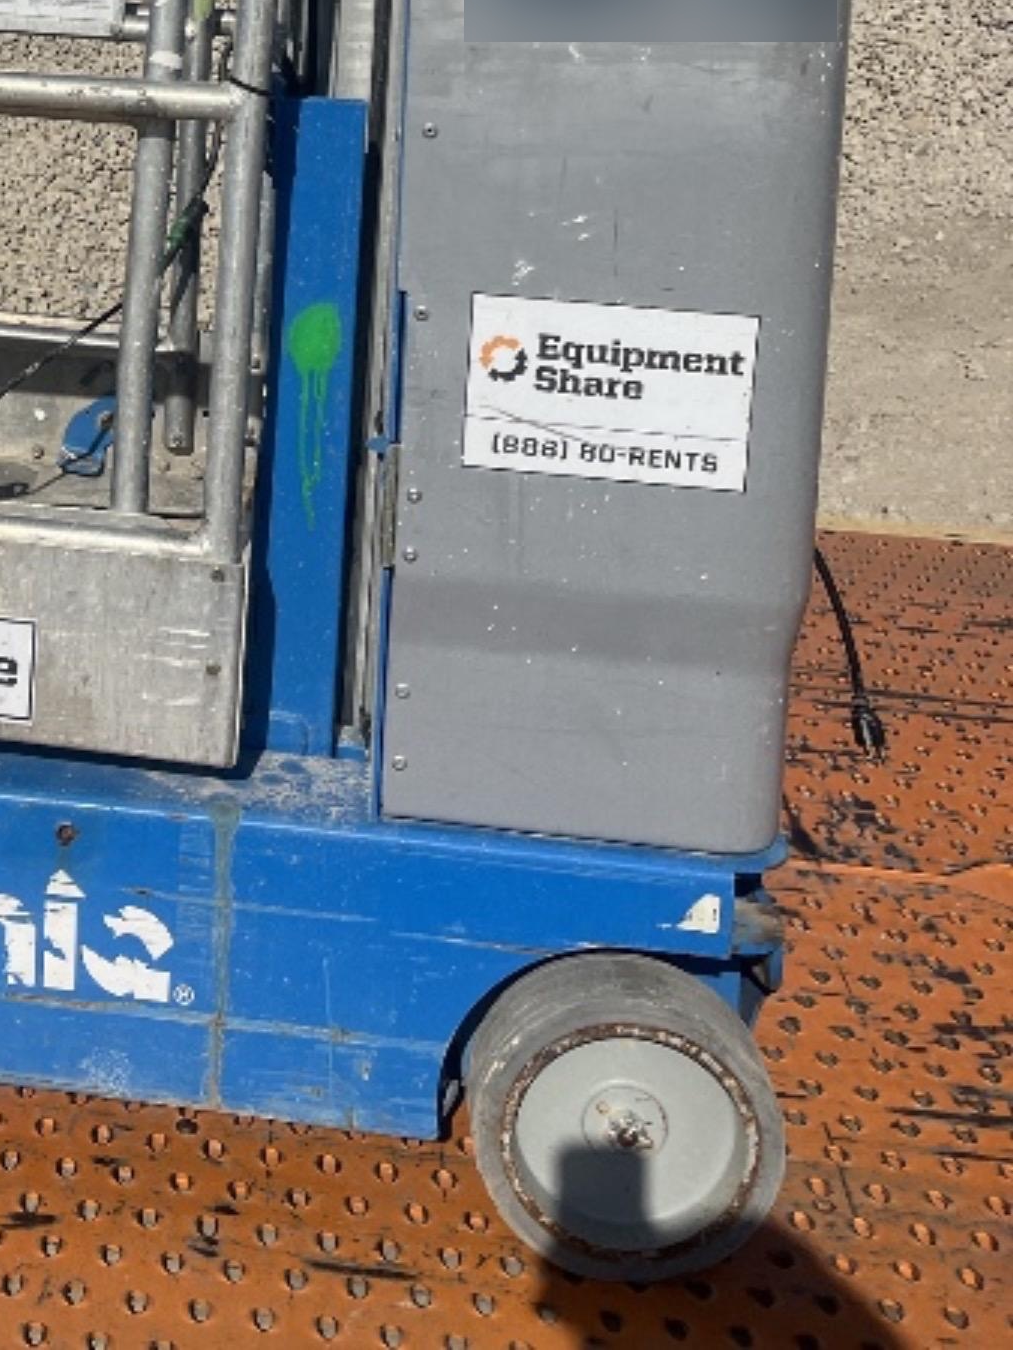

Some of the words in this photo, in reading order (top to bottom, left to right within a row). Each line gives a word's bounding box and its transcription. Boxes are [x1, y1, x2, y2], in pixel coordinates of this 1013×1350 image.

[536, 332, 745, 377] Equipment
[534, 365, 644, 400] Share
[491, 432, 568, 461] (888)
[579, 440, 719, 474] 80-RENTS
